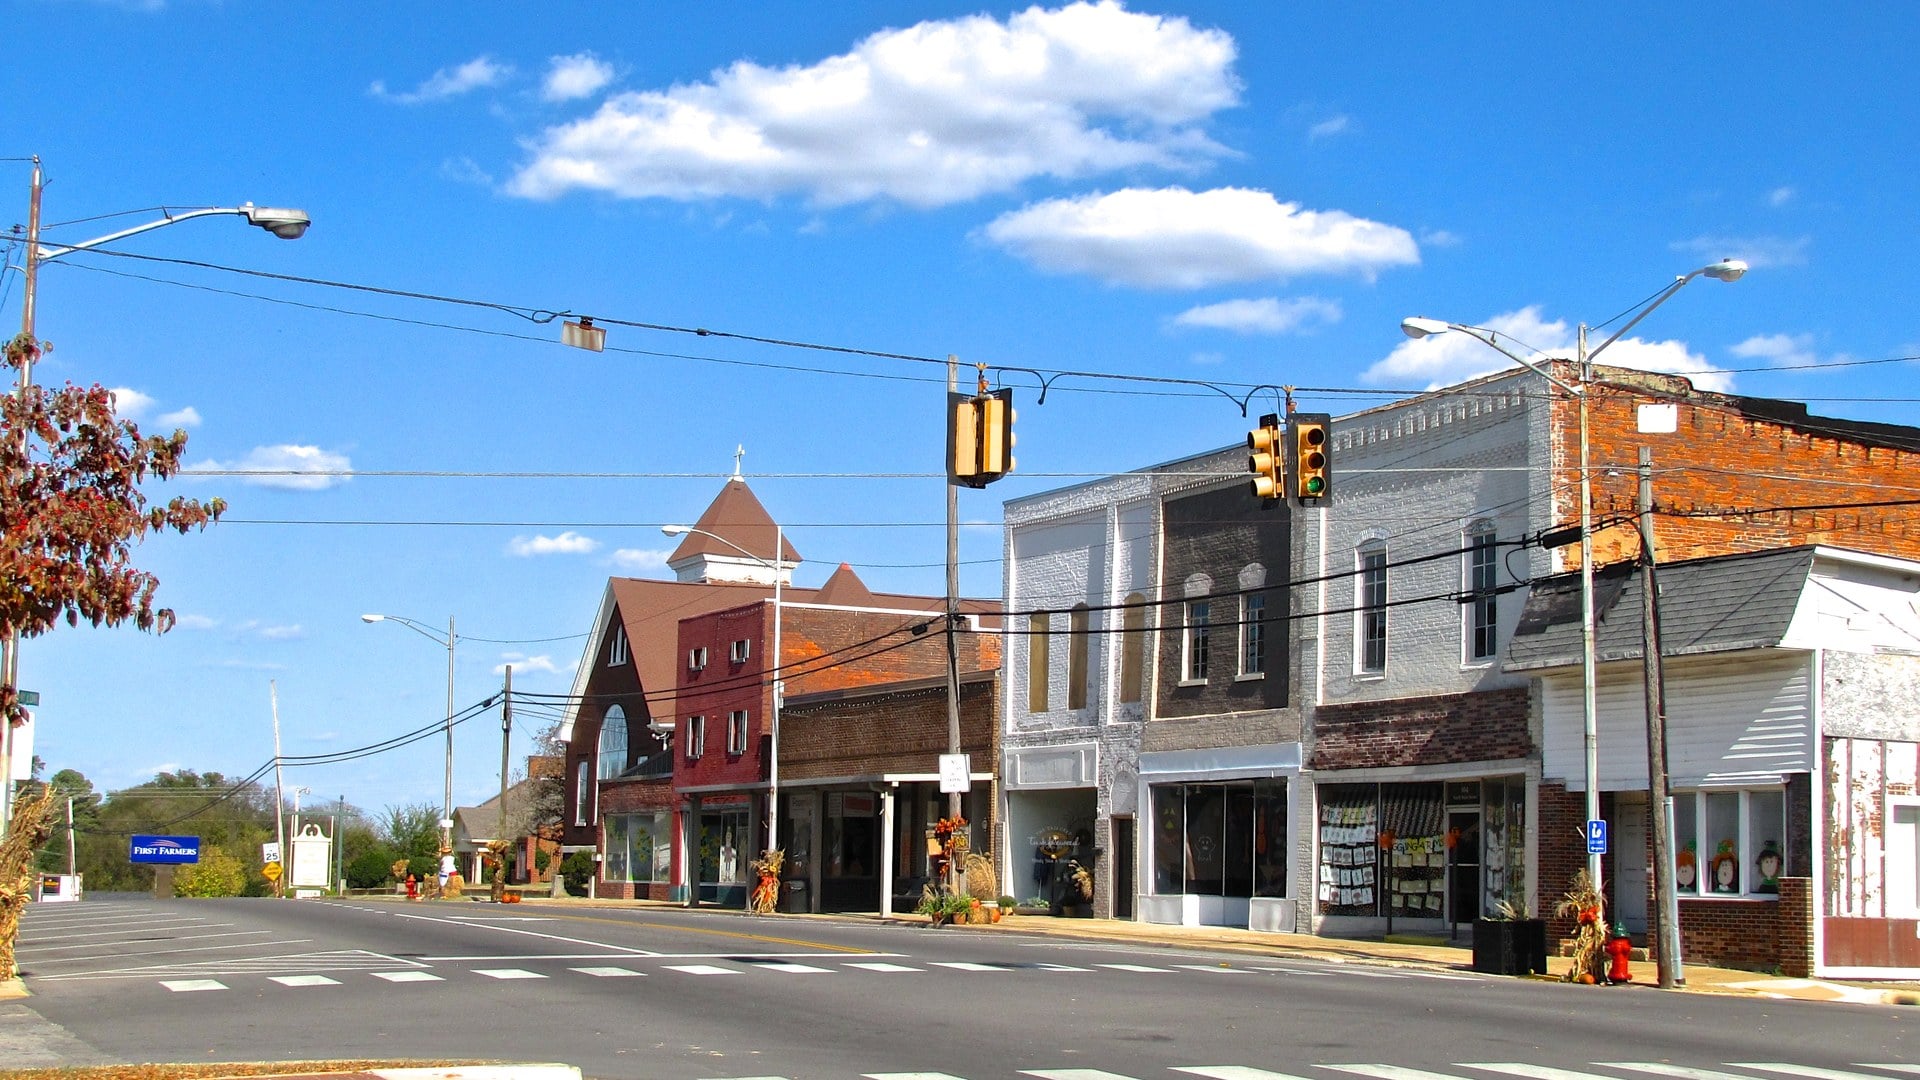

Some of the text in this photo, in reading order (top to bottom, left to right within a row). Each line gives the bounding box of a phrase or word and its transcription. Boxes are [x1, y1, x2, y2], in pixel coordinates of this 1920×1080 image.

[134, 846, 197, 856] FIRST FARMERS
[266, 852, 278, 861] 25
